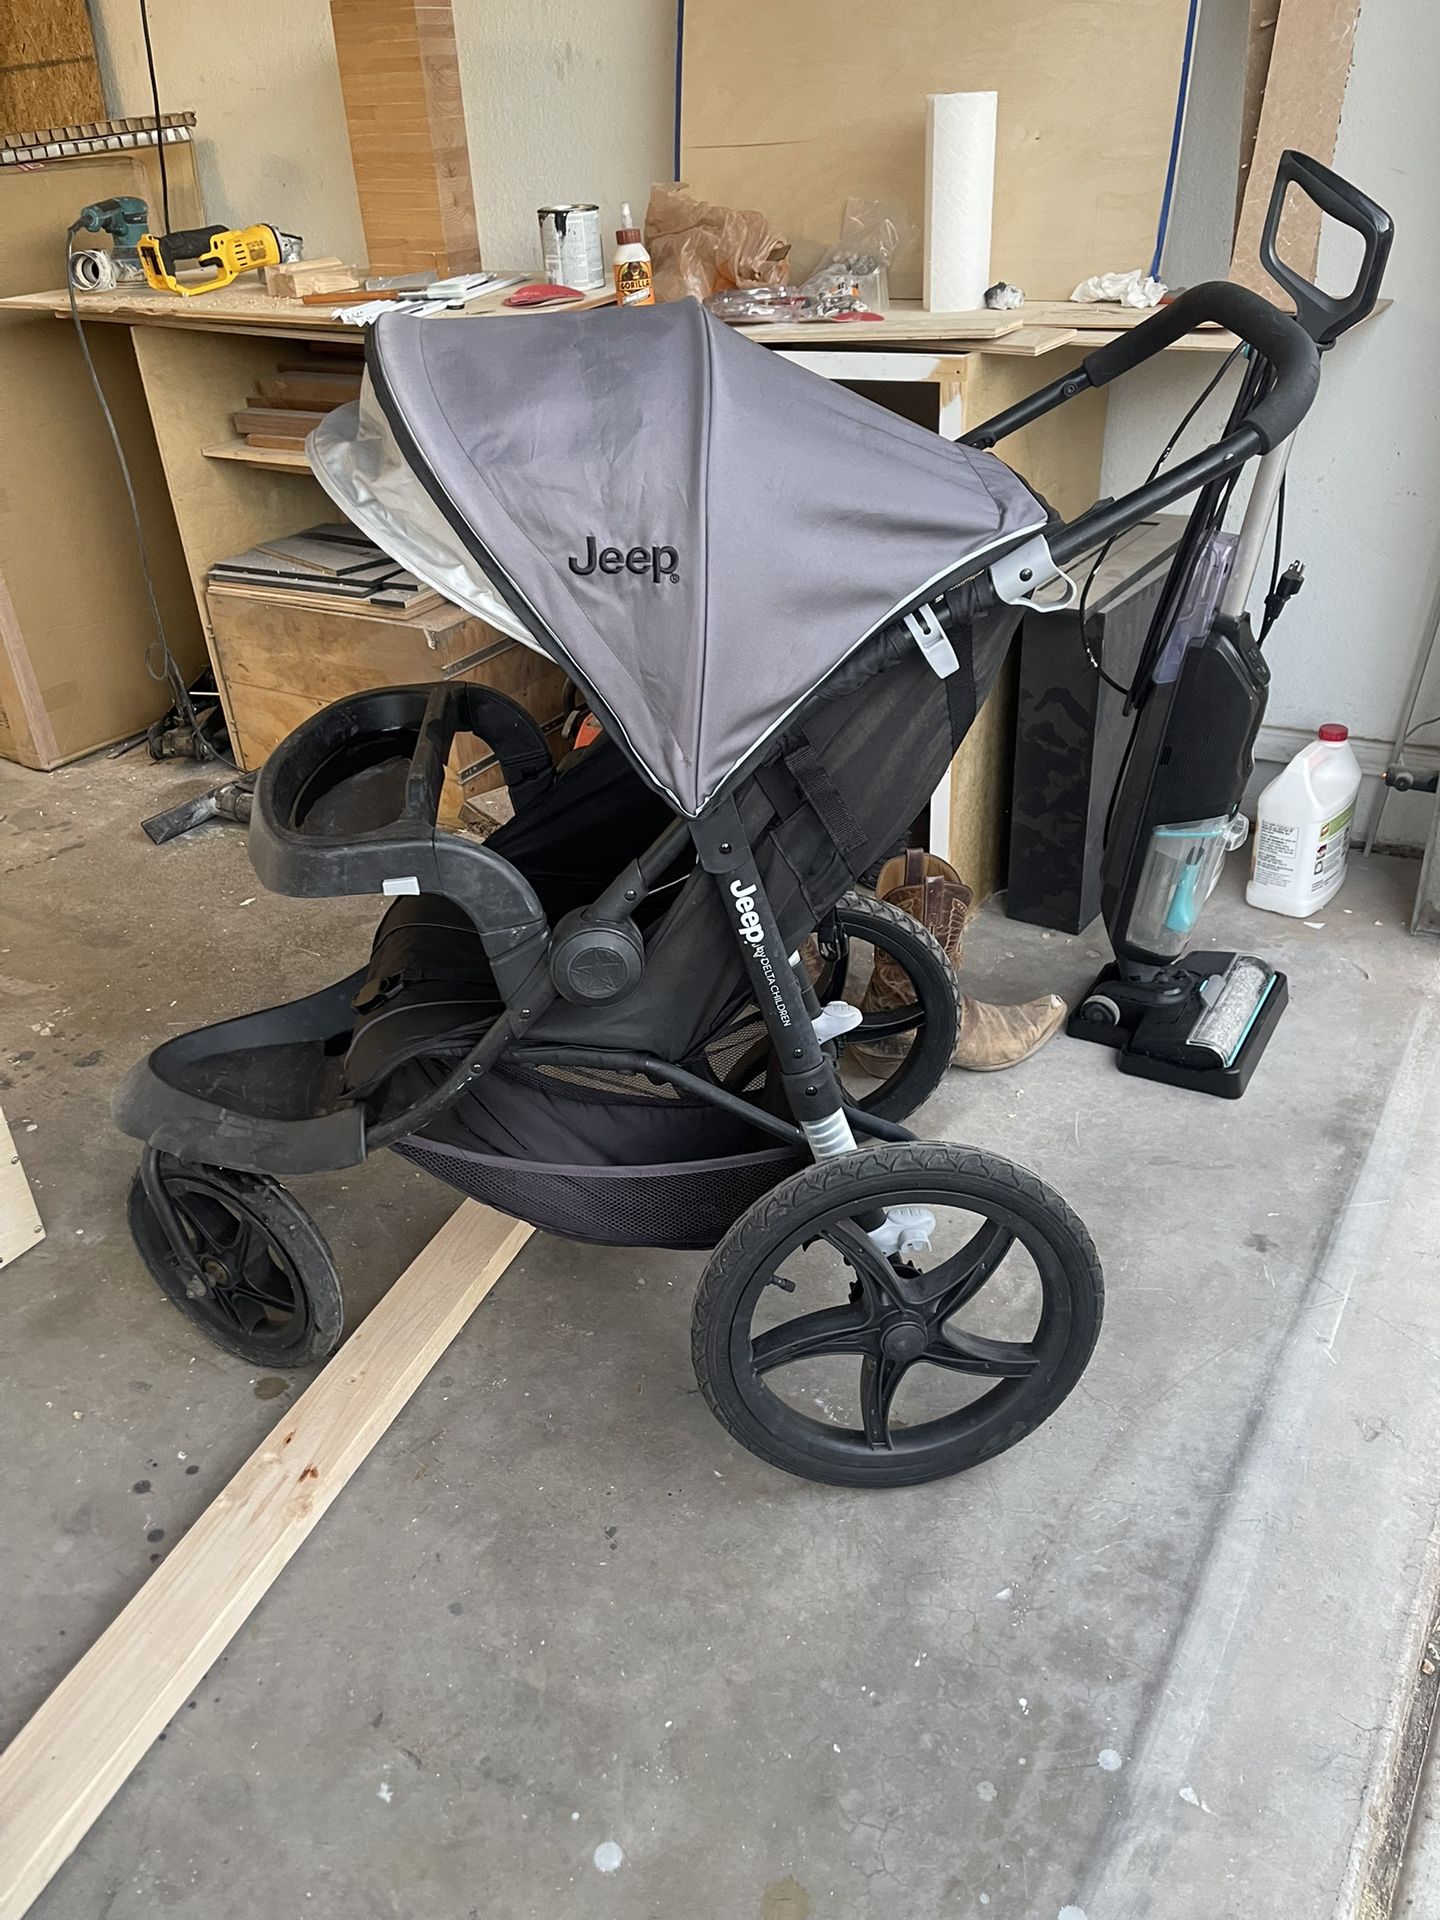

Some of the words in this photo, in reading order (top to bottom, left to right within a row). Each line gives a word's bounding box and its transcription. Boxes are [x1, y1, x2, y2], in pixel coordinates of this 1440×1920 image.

[620, 279, 650, 290] GORILLA
[568, 536, 679, 584] Jeep
[729, 879, 765, 944] Jeep
[760, 957, 776, 985] DELTA
[770, 985, 792, 1027] CHILDREN
